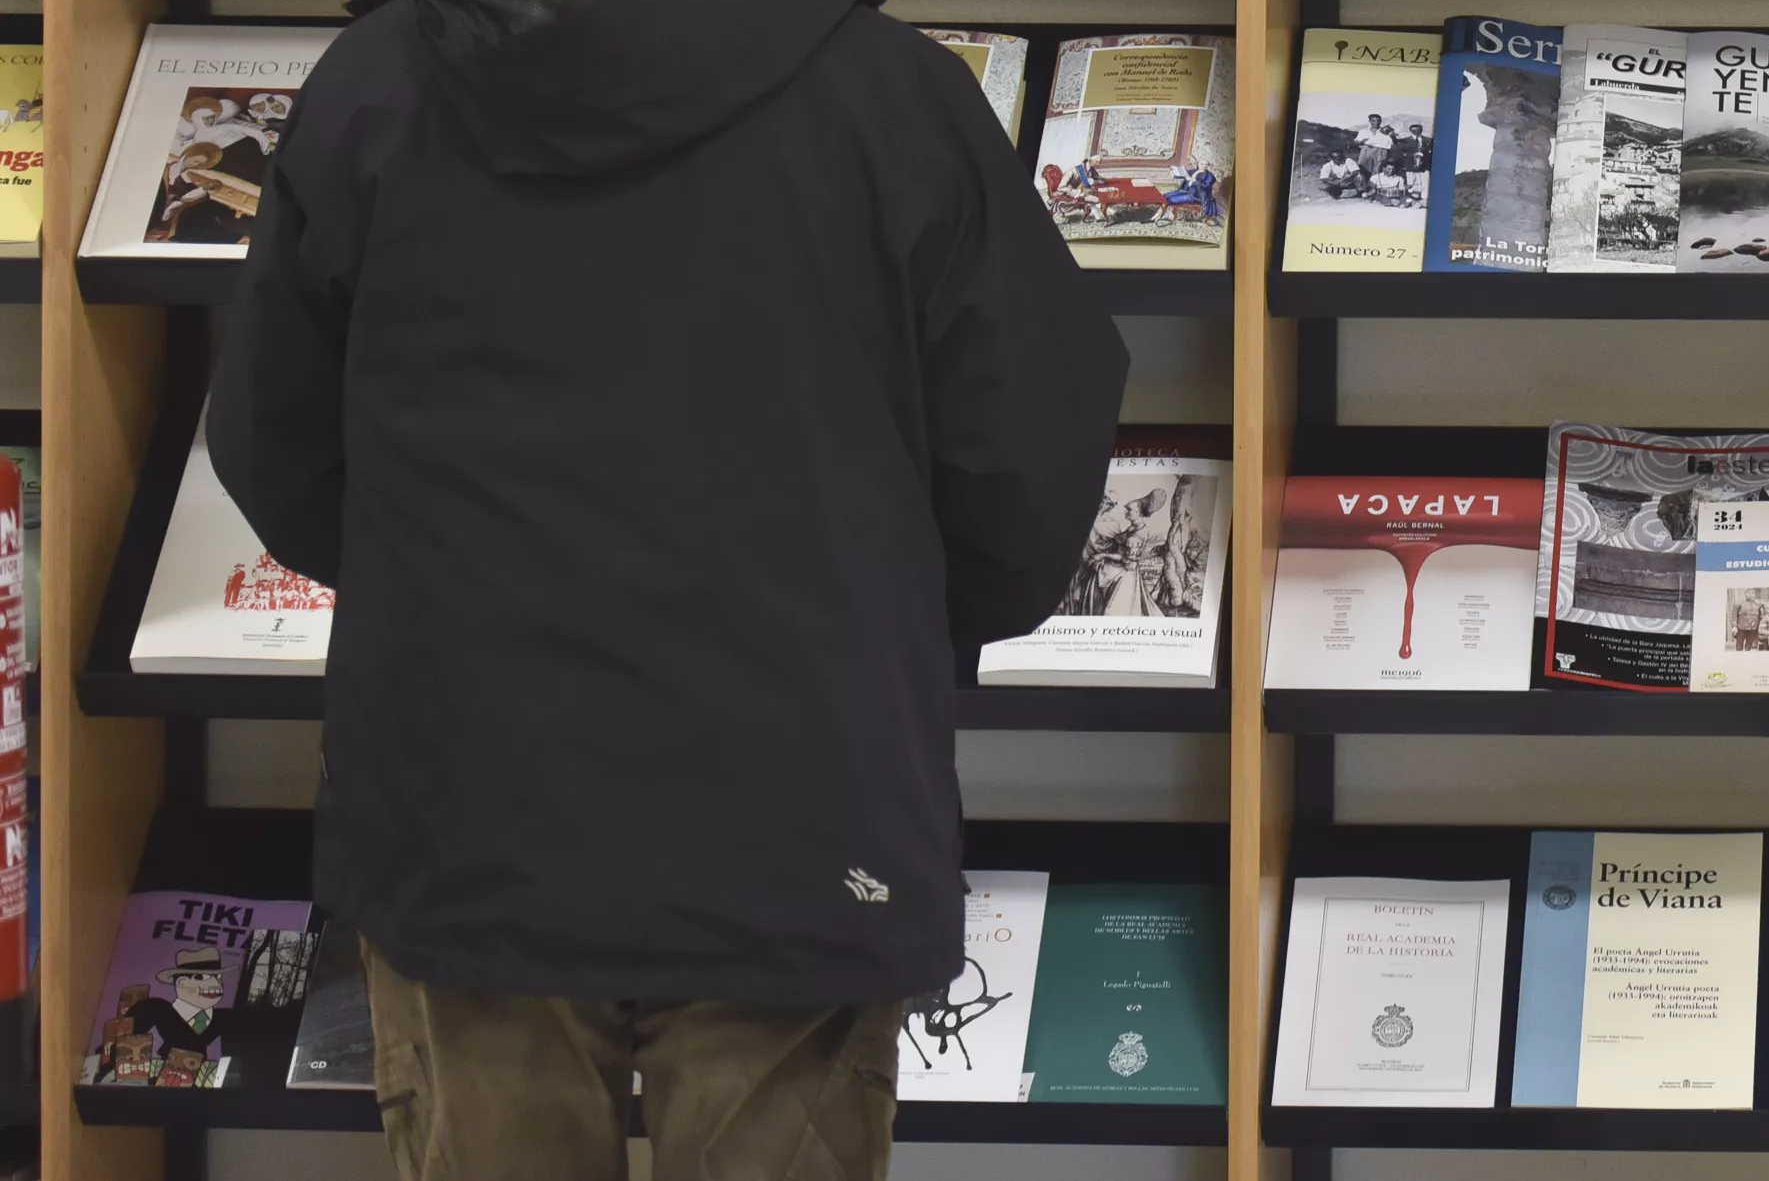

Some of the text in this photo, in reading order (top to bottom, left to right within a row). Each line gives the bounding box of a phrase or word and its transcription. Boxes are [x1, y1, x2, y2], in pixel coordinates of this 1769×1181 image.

[157, 59, 279, 76] EL ESPEJO
[1712, 91, 1753, 114] TE
[12, 176, 33, 186] fue
[1486, 236, 1508, 250] La
[1309, 242, 1407, 259] Número 27
[1337, 494, 1500, 517] LAPACA
[1714, 510, 1742, 523] 34
[1386, 521, 1445, 529] RAÚL BERNAL
[1102, 625, 1157, 637] retórica
[1161, 625, 1203, 639] visual
[1599, 862, 1718, 890] Príncipe
[1597, 887, 1724, 910] de Viana
[178, 899, 255, 928] TIKI
[1373, 904, 1435, 916] BOLETÍN
[1346, 933, 1456, 945] REAL ACADEMIA
[1346, 946, 1455, 958] DE LA HISTORIA
[1593, 946, 1700, 958] El poeta Ángel Urrutia
[1592, 965, 1645, 974] académicas
[1656, 965, 1698, 974] literarias
[1625, 982, 1720, 994] Ángel Urrutia poeta
[1654, 1001, 1719, 1011] akademikoak
[1668, 1010, 1719, 1019] literarioak
[310, 1060, 327, 1070] CD
